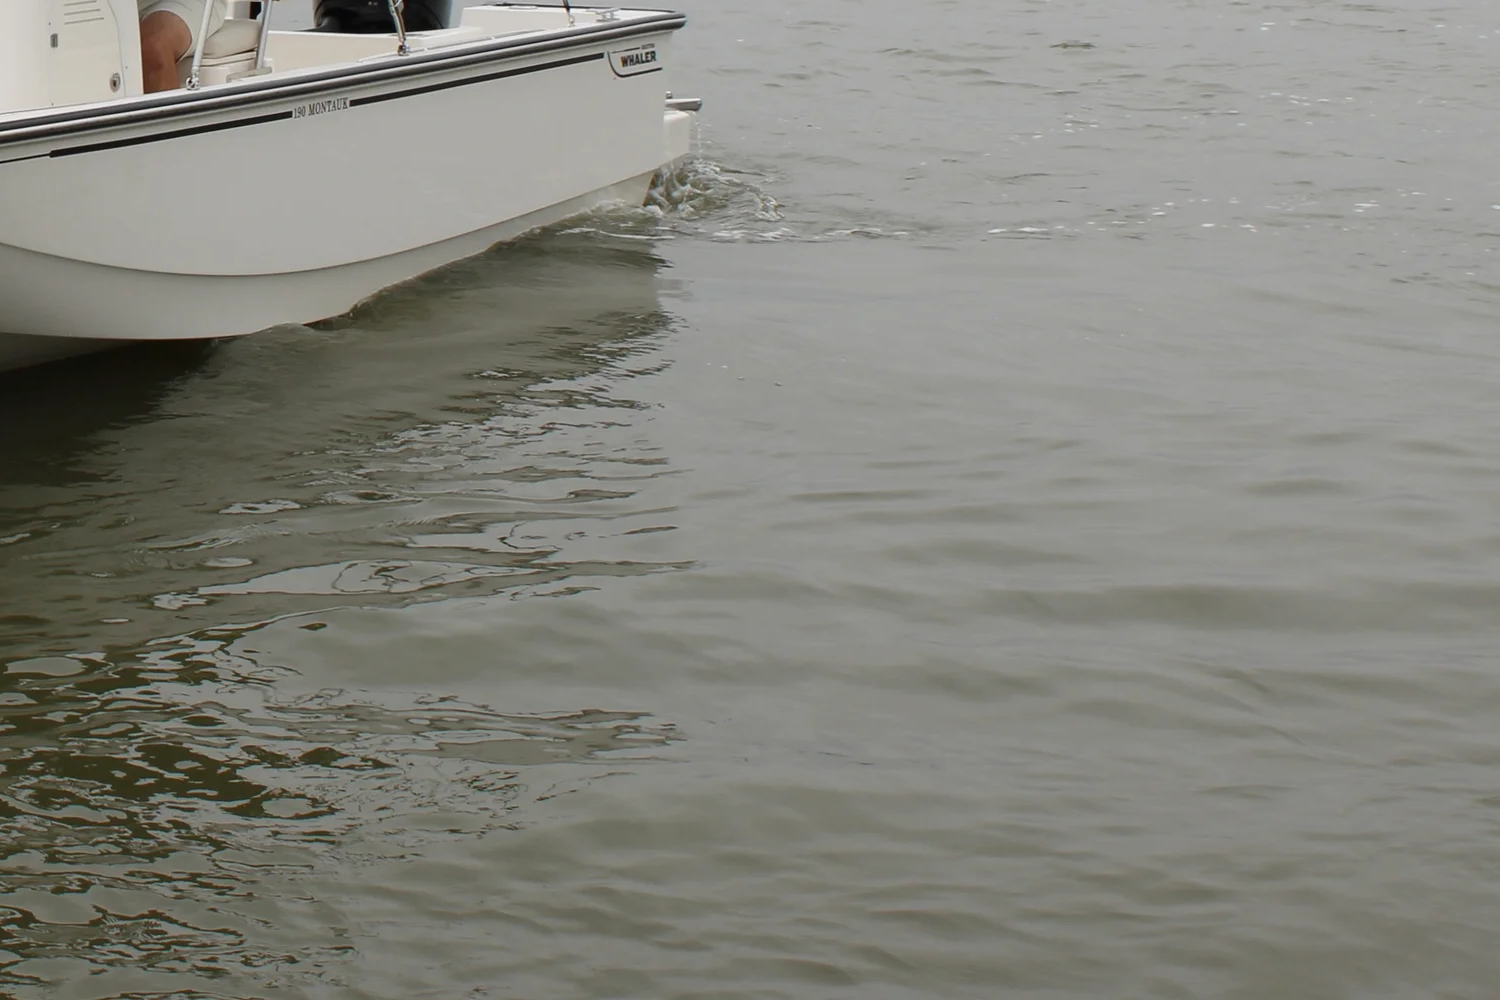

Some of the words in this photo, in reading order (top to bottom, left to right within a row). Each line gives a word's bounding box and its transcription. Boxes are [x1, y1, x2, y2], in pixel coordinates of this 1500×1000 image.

[620, 50, 657, 68] WHALER
[294, 106, 306, 119] 190
[308, 97, 349, 116] MONTAUK
